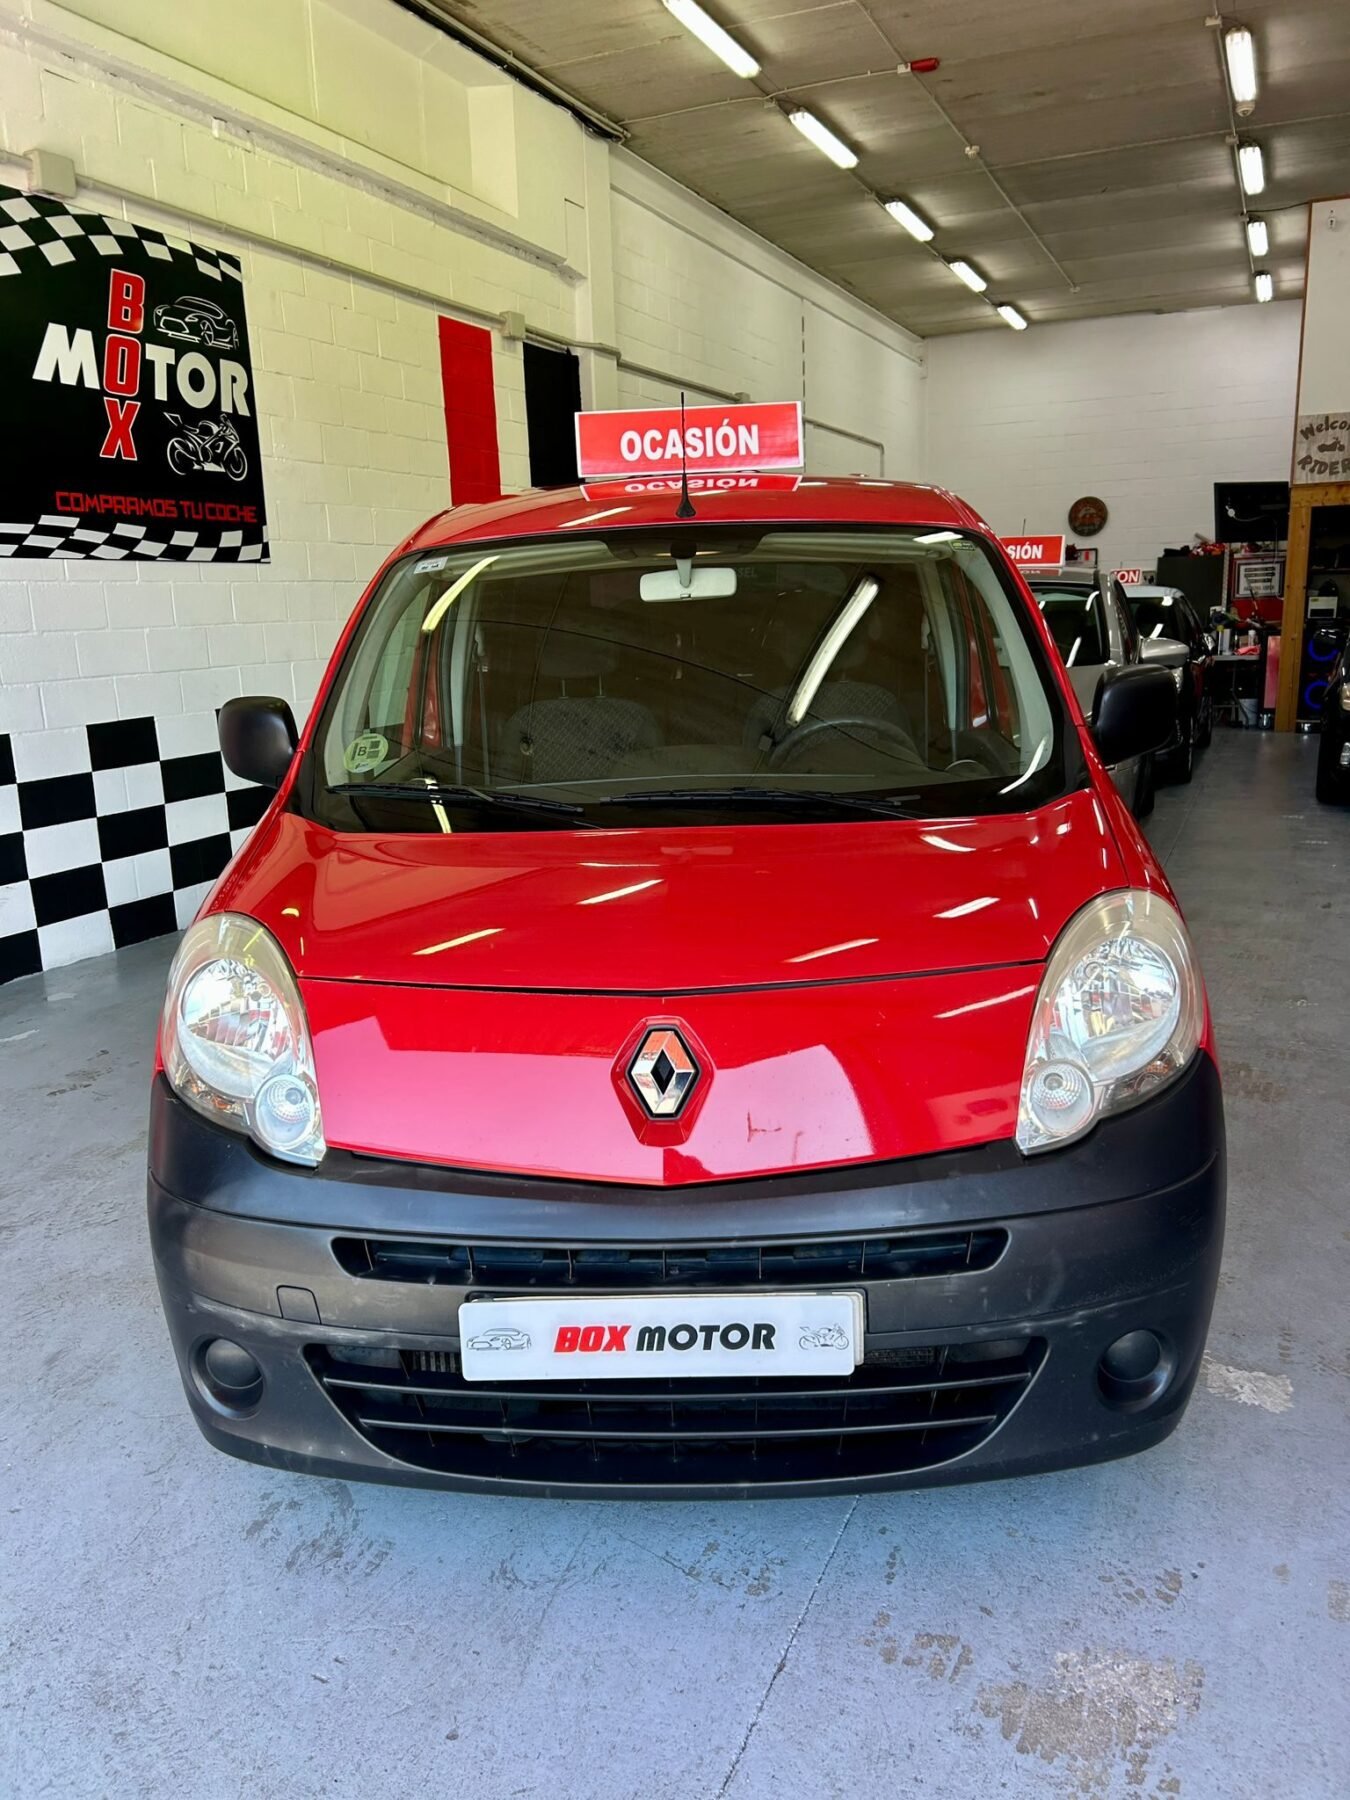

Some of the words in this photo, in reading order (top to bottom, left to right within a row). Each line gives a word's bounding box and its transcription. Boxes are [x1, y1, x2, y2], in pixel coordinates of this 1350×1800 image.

[32, 321, 251, 418] MOTOR
[99, 268, 146, 462] BOX
[620, 418, 759, 461] OCASIÓN
[1300, 415, 1350, 441] Welco
[56, 491, 178, 518] COMPRAMOS
[179, 501, 204, 521] TU
[204, 503, 258, 524] COCHE
[553, 1324, 632, 1353] BOX
[636, 1323, 776, 1353] MOTOR
